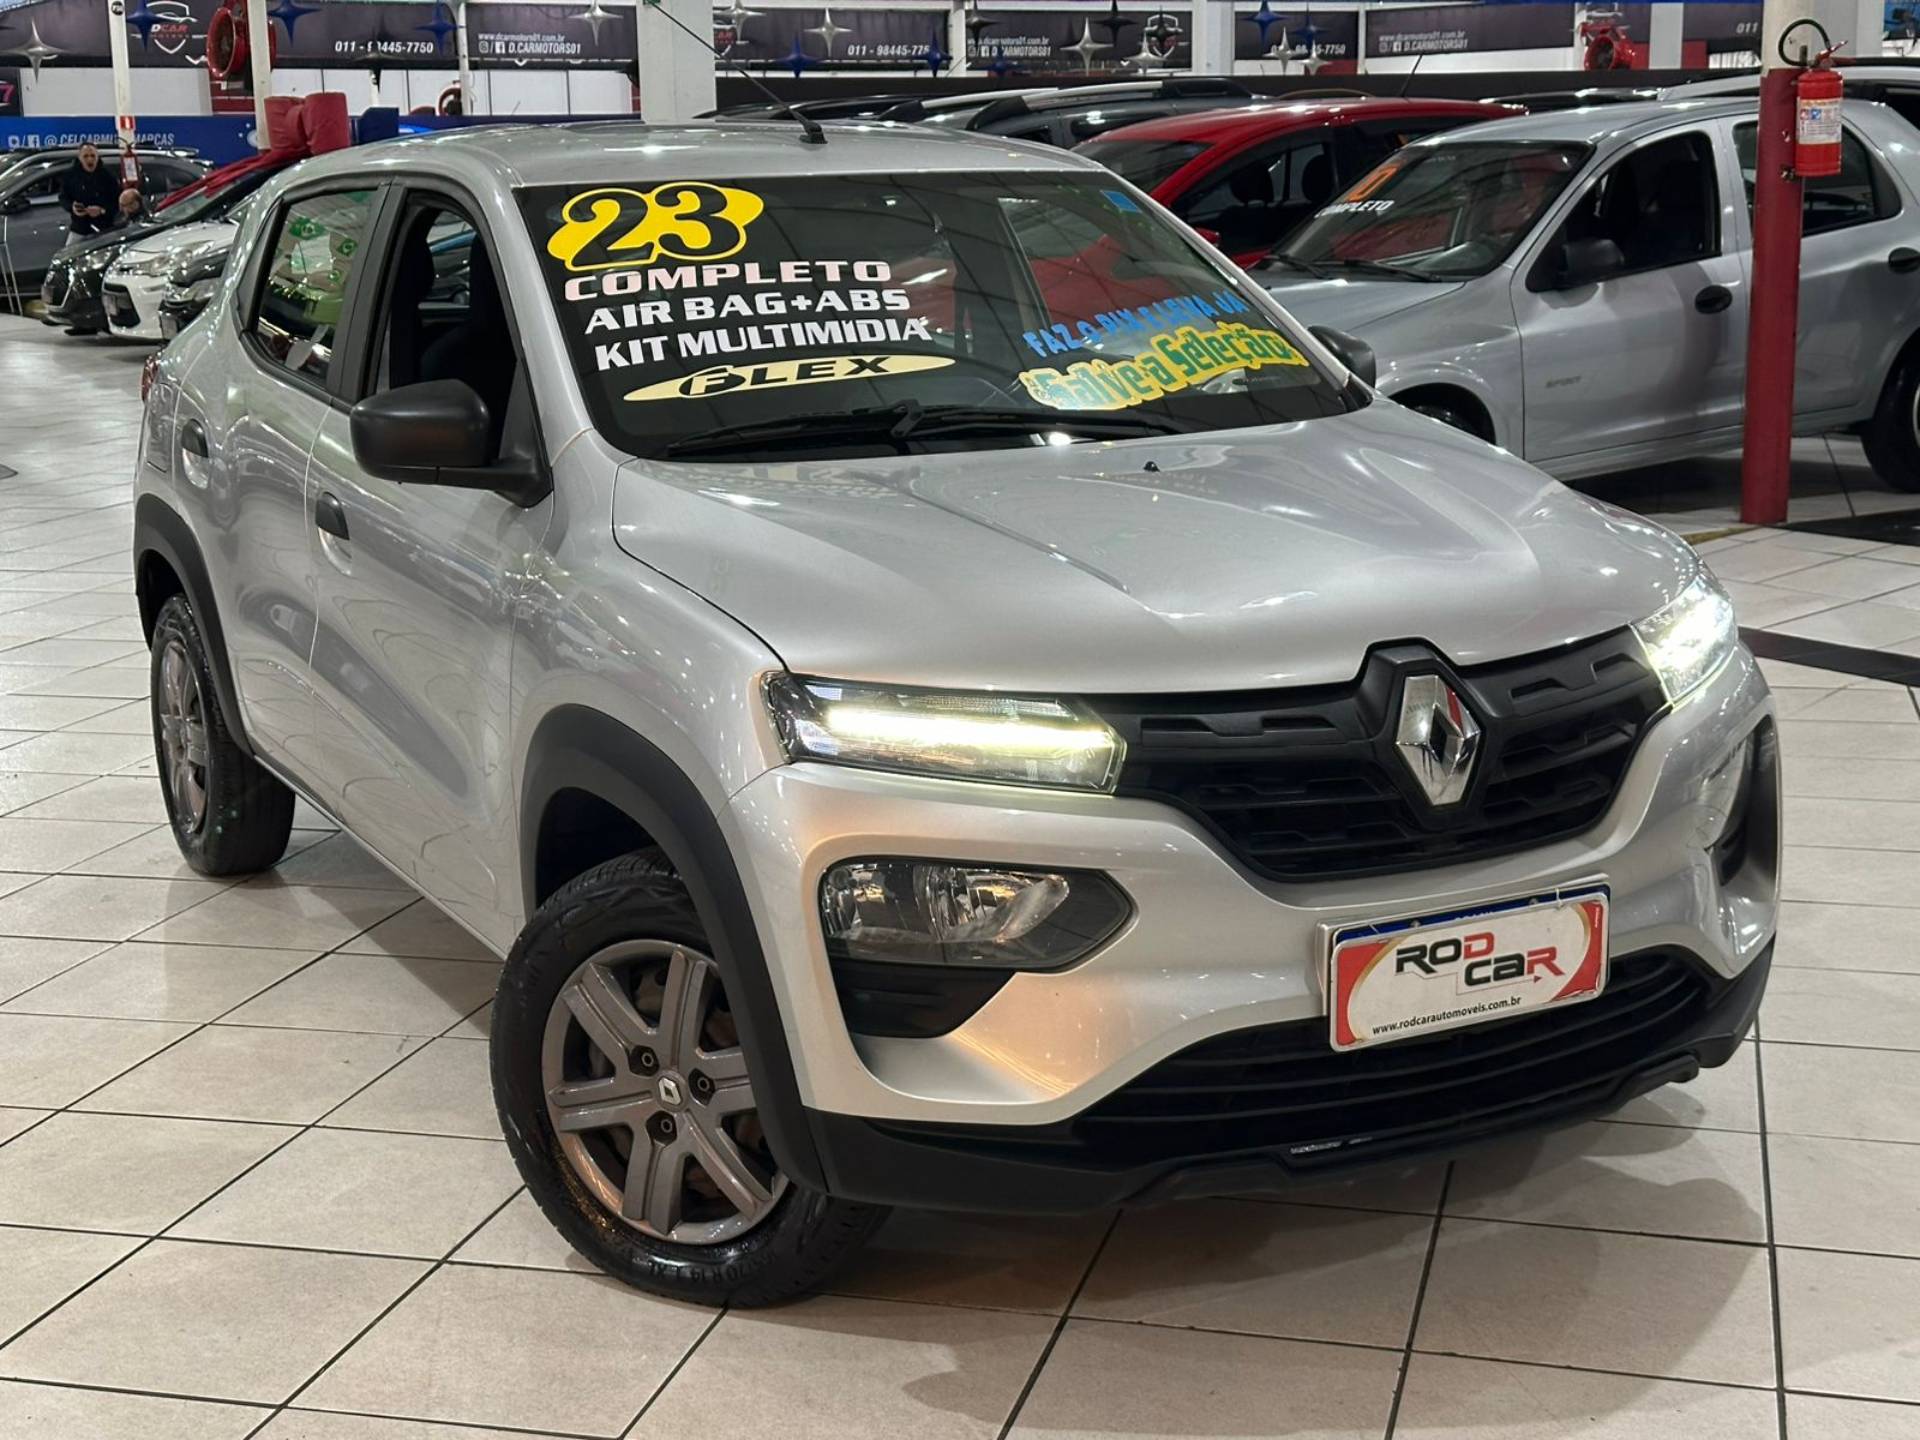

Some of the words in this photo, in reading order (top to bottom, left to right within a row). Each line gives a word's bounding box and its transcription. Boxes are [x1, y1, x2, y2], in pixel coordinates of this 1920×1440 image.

[335, 40, 356, 52] 011
[1736, 22, 1758, 33] 011
[848, 45, 866, 56] 011
[562, 181, 747, 271] 23
[565, 260, 892, 301] COMPLETO
[585, 299, 673, 334] AIR
[685, 289, 911, 322] BAG+ABS
[595, 335, 668, 371] KIT
[1023, 323, 1083, 357] FAZ
[679, 356, 892, 398] FLEX
[1395, 931, 1496, 975] ROD
[1372, 996, 1522, 1035] www.rodcarautomoveis.com.br
